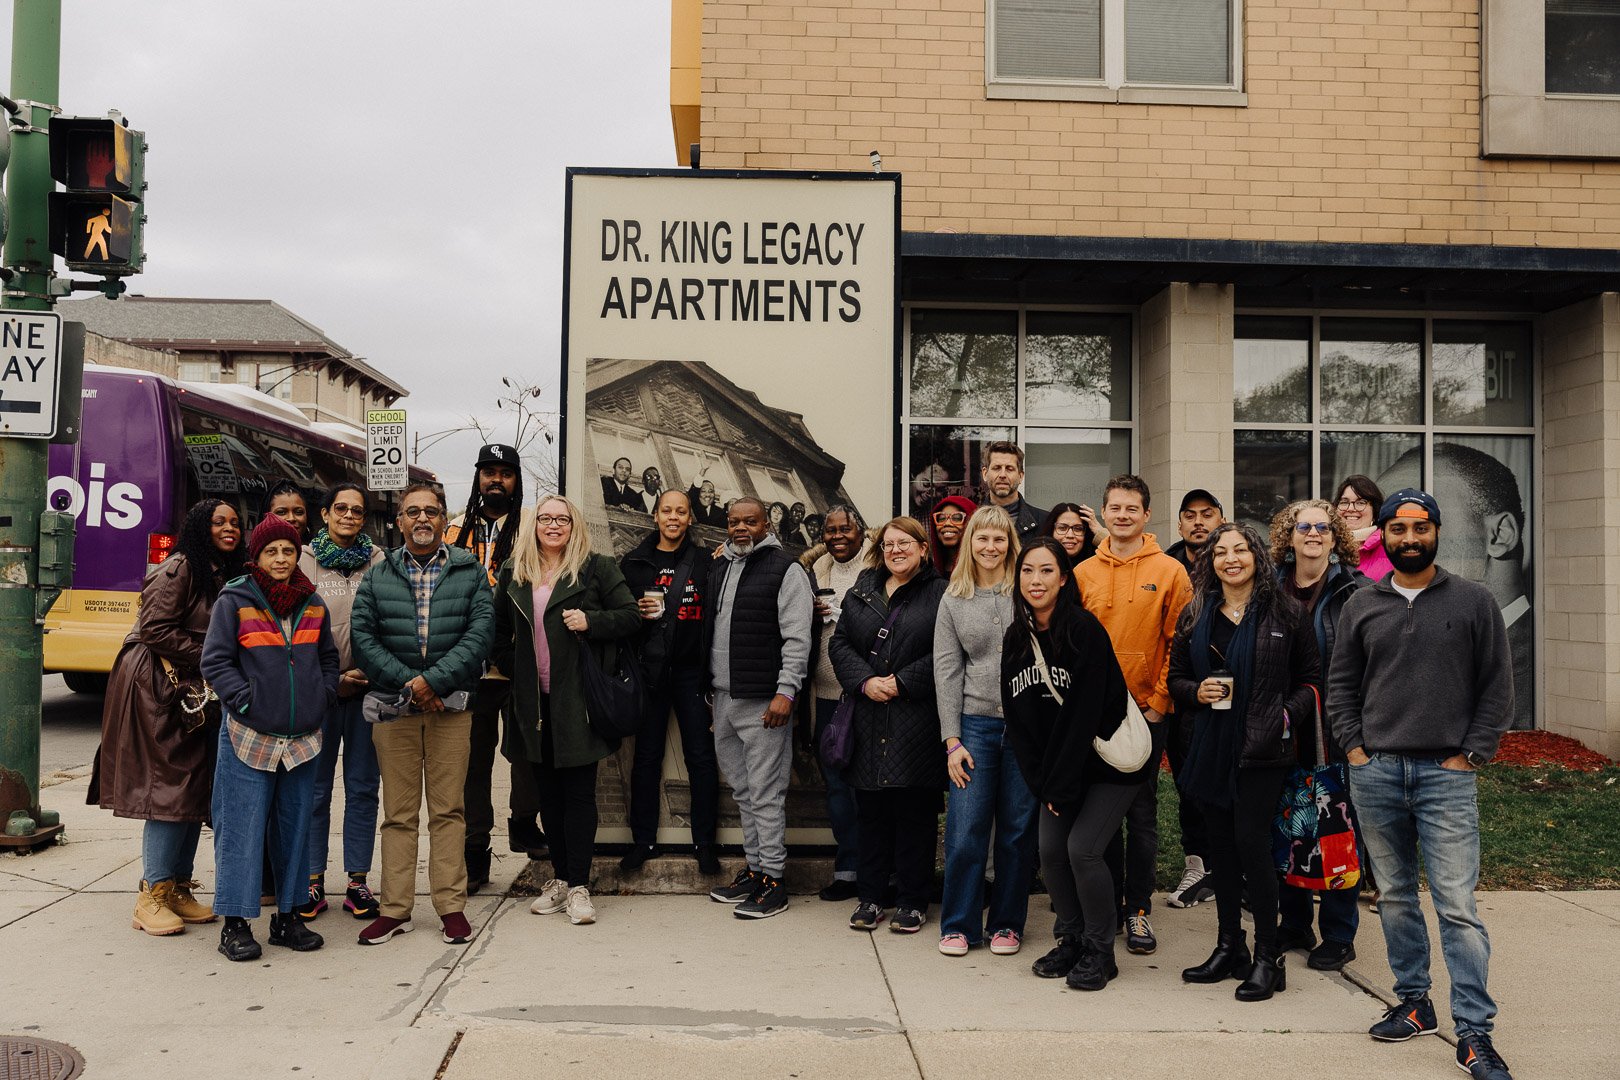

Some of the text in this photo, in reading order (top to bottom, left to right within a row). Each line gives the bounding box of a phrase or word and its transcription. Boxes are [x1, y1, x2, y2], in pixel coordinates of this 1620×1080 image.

[601, 219, 865, 265] DR. KING LEGACY
[600, 276, 861, 322] APARTMENTS
[2, 322, 45, 349] NE
[2, 355, 46, 382] AY
[1485, 351, 1516, 400] BIT
[369, 412, 404, 422] SCHOOL
[370, 426, 403, 435] SPEED
[373, 436, 399, 445] LIMIT
[372, 447, 402, 465] 20
[47, 462, 143, 529] ois
